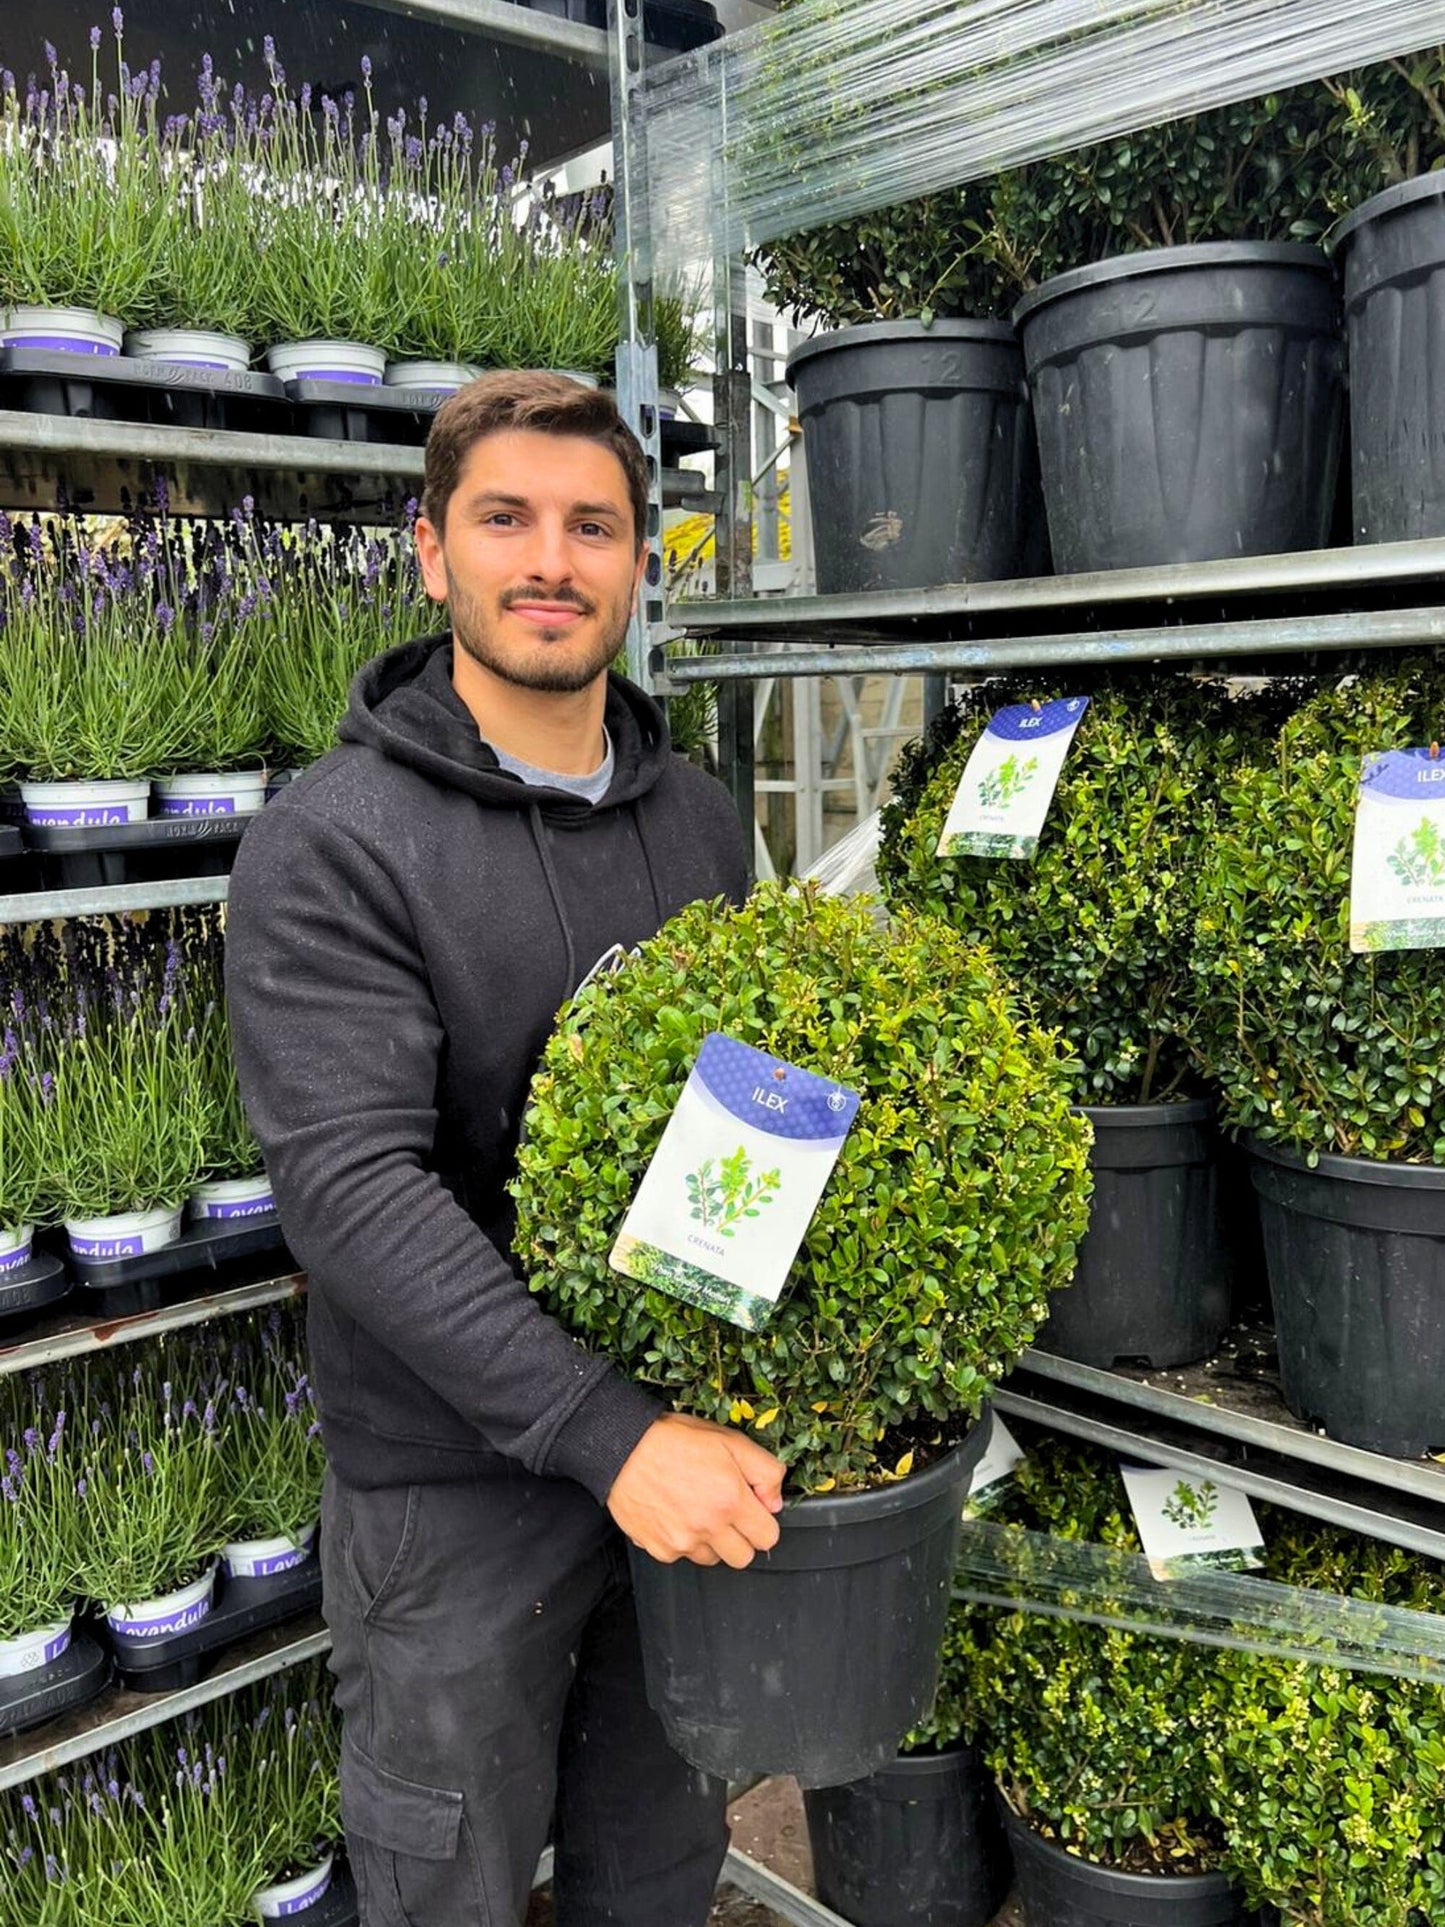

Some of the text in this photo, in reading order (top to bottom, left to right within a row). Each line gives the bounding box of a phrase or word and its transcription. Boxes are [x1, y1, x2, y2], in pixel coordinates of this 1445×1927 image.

[224, 372, 254, 391] 408
[1018, 717, 1043, 728] ILEX
[752, 1086, 789, 1114] ILEX
[687, 1234, 726, 1257] CRENATA
